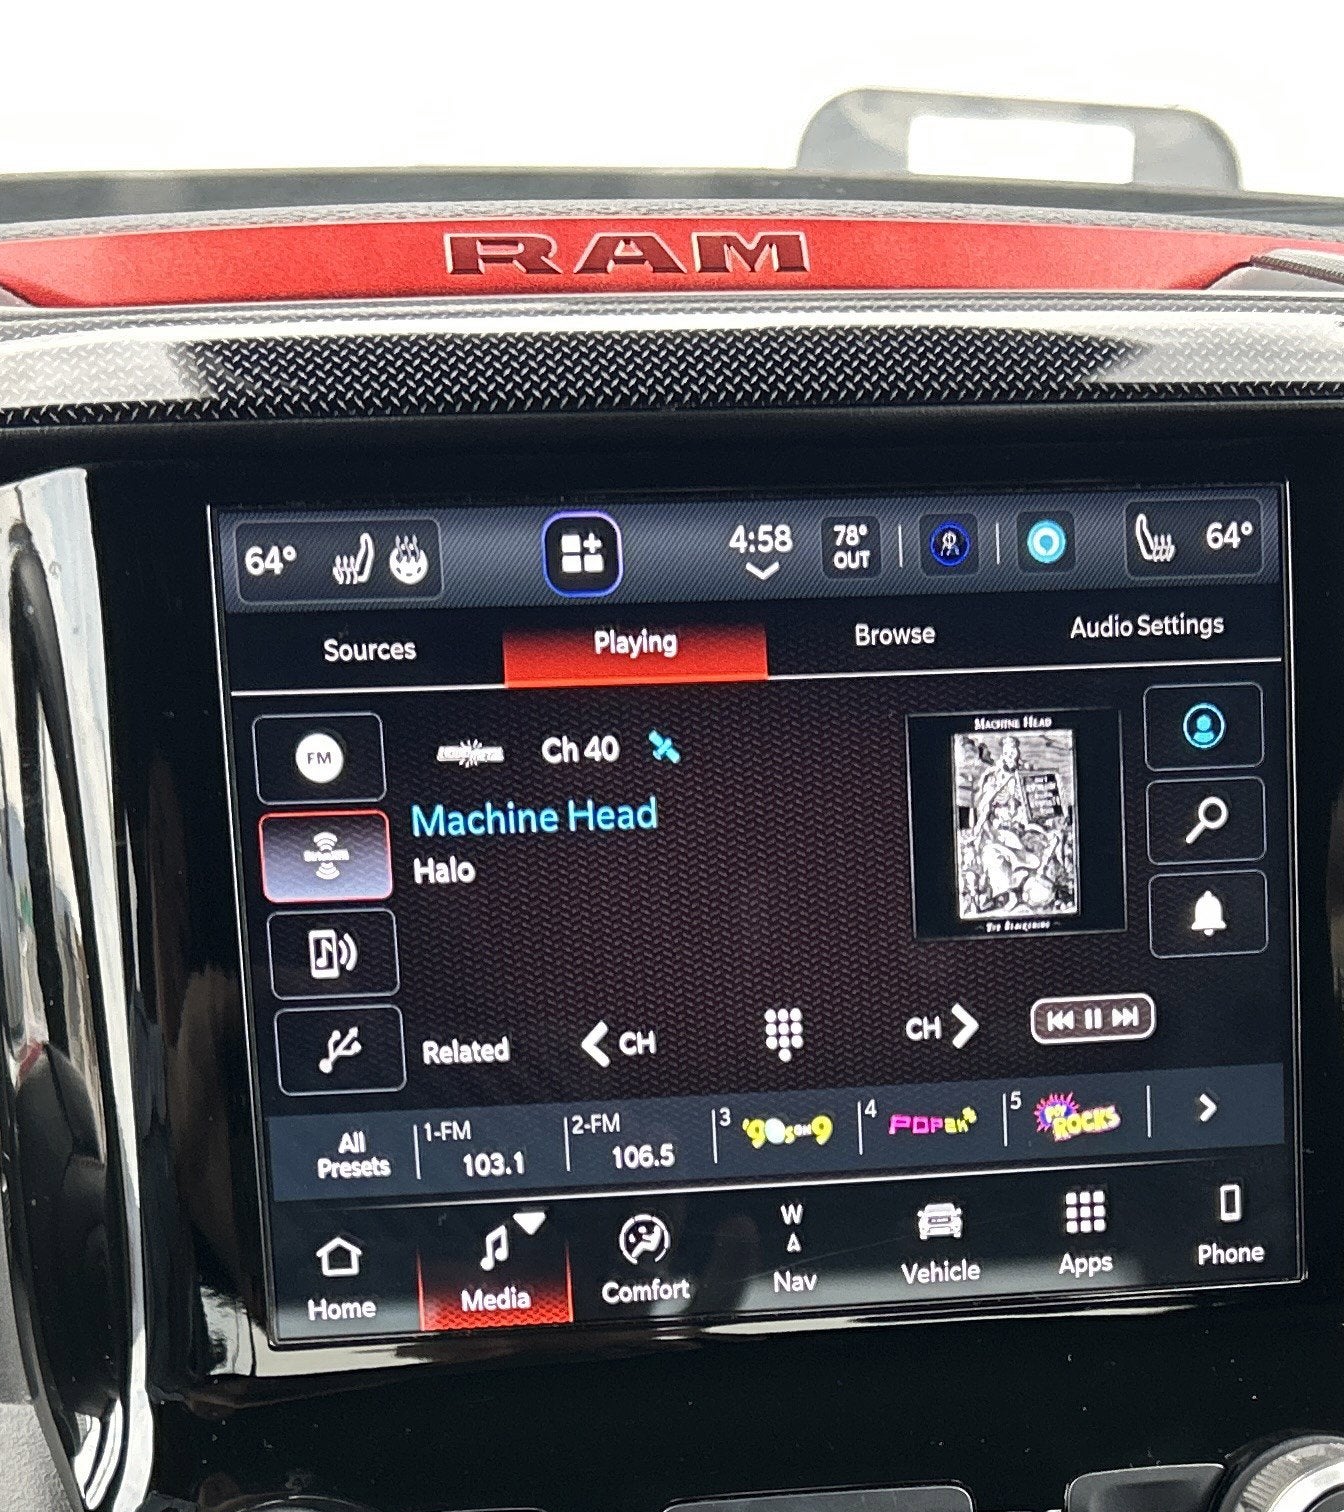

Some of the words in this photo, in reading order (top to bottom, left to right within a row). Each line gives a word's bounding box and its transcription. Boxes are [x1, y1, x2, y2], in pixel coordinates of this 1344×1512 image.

[443, 231, 810, 276] RAM
[729, 524, 793, 554] 4:58
[833, 524, 868, 547] 78°
[1206, 520, 1253, 550] 64°
[245, 544, 297, 575] 64°
[833, 549, 870, 570] OUT
[855, 622, 936, 647] Browse
[1070, 614, 1132, 639] Audio
[1137, 613, 1224, 642] Settings
[323, 638, 416, 662] Sources
[594, 630, 678, 659] Playing
[306, 750, 332, 767] FM
[542, 736, 578, 763] Ch
[584, 736, 620, 762] 40
[411, 802, 558, 838] Machine
[568, 796, 658, 830] Head
[414, 857, 476, 884] Halo
[906, 1015, 942, 1041] CH
[423, 1036, 510, 1065] Related
[619, 1031, 656, 1056] CH
[864, 1098, 878, 1118] 4
[1010, 1090, 1023, 1111] 5
[572, 1112, 621, 1136] 2-FM
[719, 1107, 732, 1128] 3
[338, 1131, 366, 1154] All
[424, 1121, 472, 1143] 1-FM
[317, 1156, 391, 1180] Presets
[463, 1151, 525, 1177] 103.1
[612, 1144, 676, 1170] 106.5
[1058, 1253, 1113, 1279] Apps
[1199, 1242, 1264, 1266] Phone
[773, 1271, 818, 1293] Nav
[901, 1259, 981, 1285] Vehicle
[461, 1288, 531, 1313] Media
[602, 1277, 691, 1306] Comfort
[309, 1298, 377, 1321] Home
